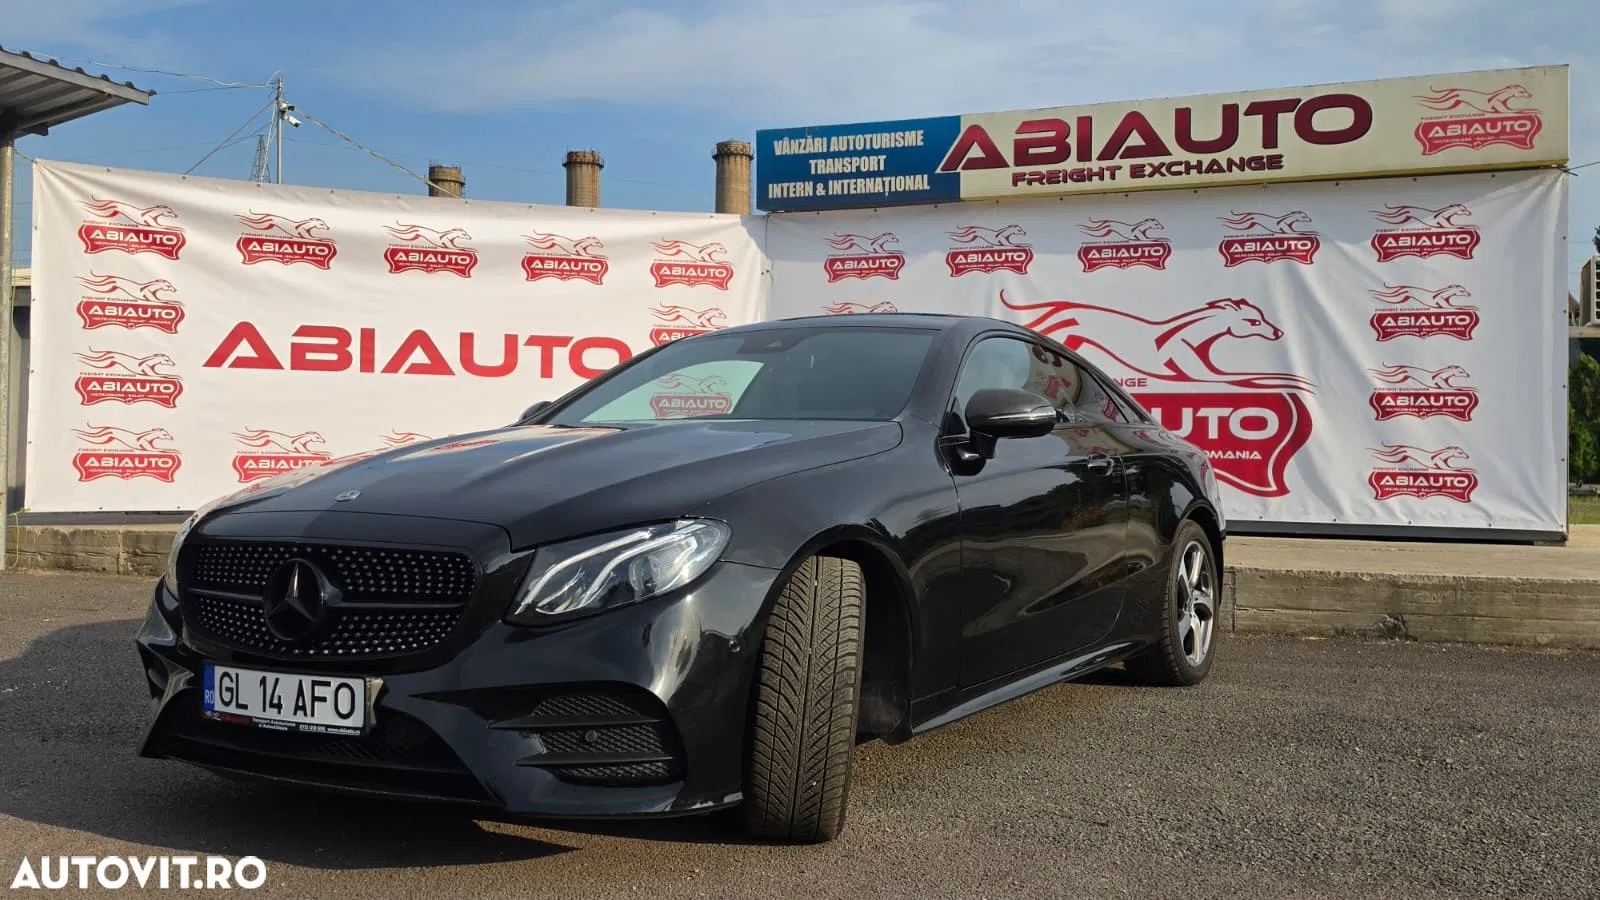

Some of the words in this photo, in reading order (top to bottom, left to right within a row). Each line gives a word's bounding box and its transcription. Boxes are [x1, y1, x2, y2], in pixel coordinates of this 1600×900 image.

[938, 92, 1373, 172] ABIAUTO
[1428, 120, 1532, 138] ABIAUTO
[830, 130, 924, 152] AUTOTURISME
[809, 155, 886, 175] TRANSPORT
[1012, 164, 1121, 187] FREIGHT
[1129, 153, 1284, 179] EXCHANGE
[768, 182, 813, 199] INTERN
[815, 182, 826, 196] &
[90, 229, 177, 246] ABIAUTO
[1380, 234, 1470, 248] ABIAUTO
[247, 240, 330, 257] ABIAUTO
[1087, 245, 1164, 260] ABIAUTO
[1228, 239, 1312, 253] ABIAUTO
[394, 251, 470, 265] ABIAUTO
[832, 257, 899, 270] ABIAUTO
[953, 250, 1026, 264] ABIAUTO
[530, 258, 602, 272] ABIAUTO
[659, 266, 729, 279] ABIAUTO
[88, 305, 176, 319] ABIAUTO
[1382, 315, 1470, 327] ABIAUTO
[202, 320, 633, 380] ABIAUTO
[86, 380, 174, 394] ABIAUTO
[658, 398, 727, 409] ABIAUTO
[1380, 395, 1471, 408] ABIAUTO
[1204, 449, 1263, 460] OMANIA
[84, 455, 172, 469] ABIAUTO
[1379, 475, 1470, 489] ABIAUTO
[204, 689, 215, 704] RO
[219, 671, 249, 710] GL
[259, 675, 283, 715] 14
[293, 678, 356, 721] AFO
